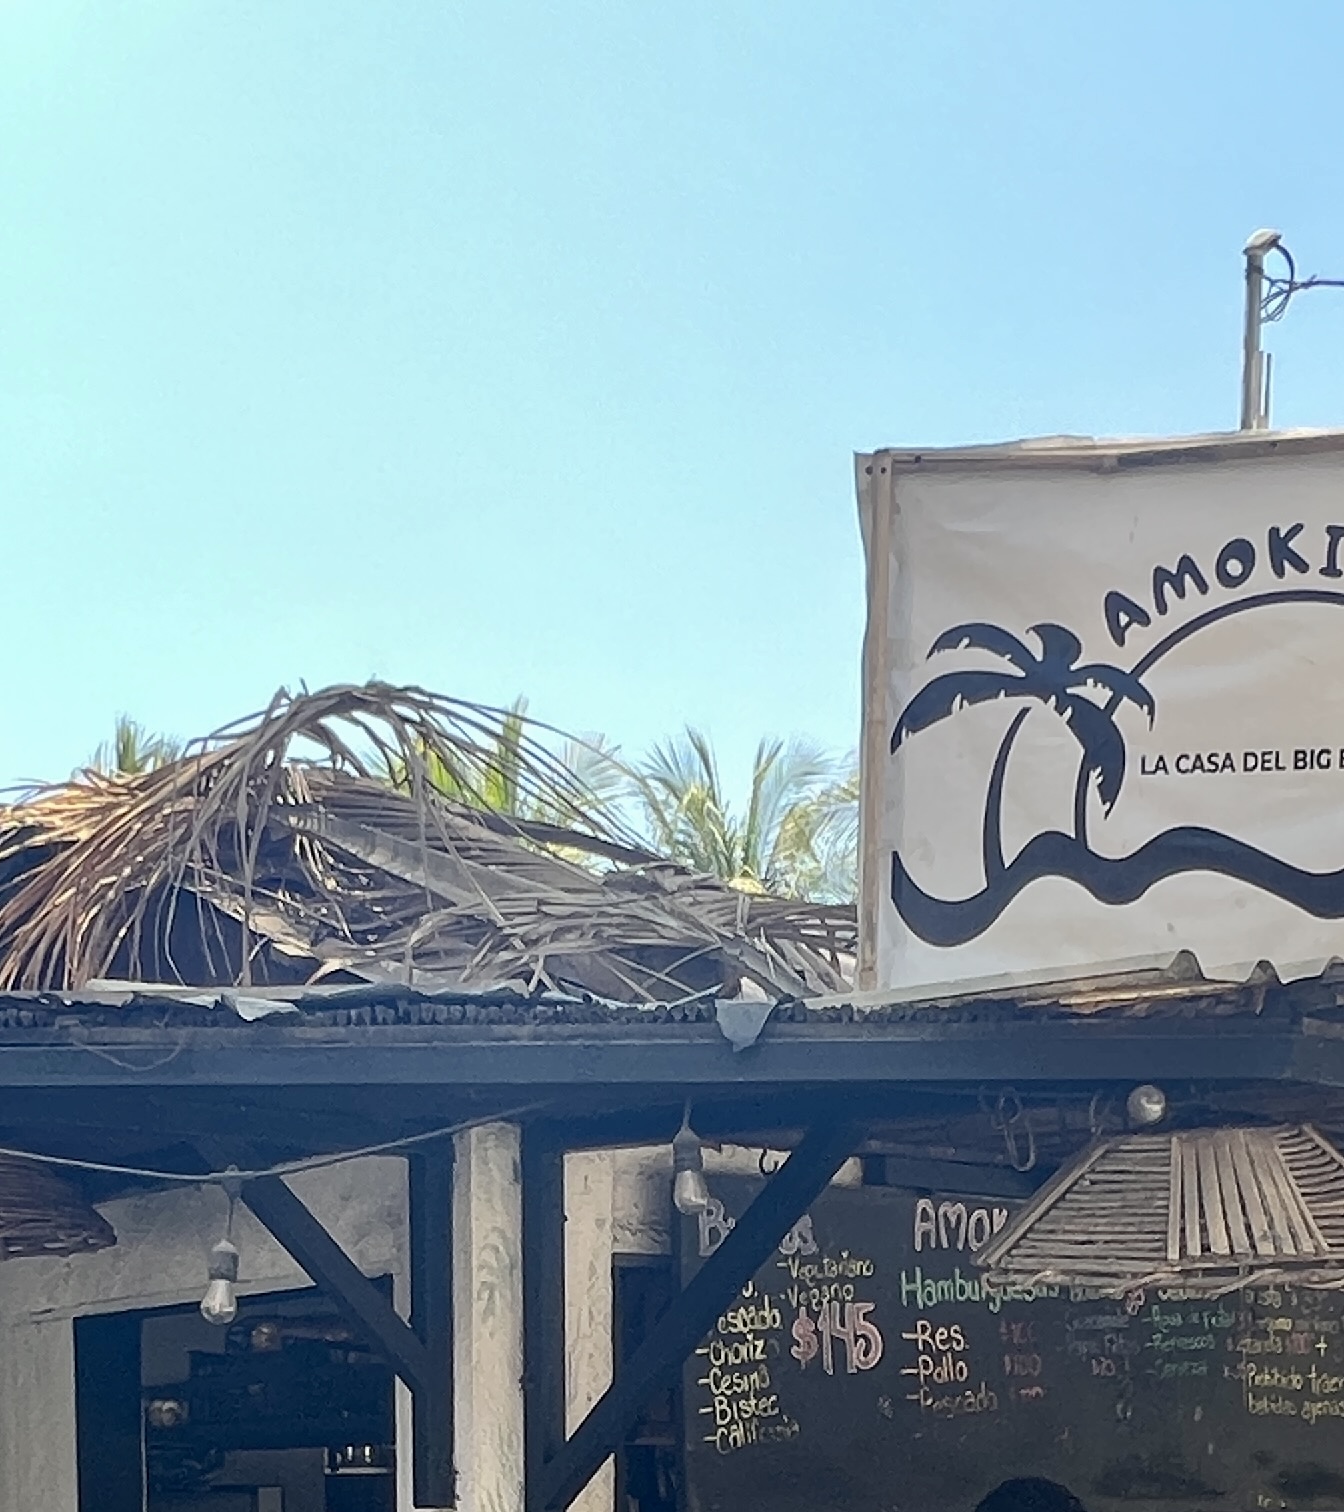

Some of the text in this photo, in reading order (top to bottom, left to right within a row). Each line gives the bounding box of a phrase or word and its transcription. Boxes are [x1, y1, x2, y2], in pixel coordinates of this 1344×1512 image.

[1140, 754, 1170, 776] LA
[1174, 752, 1236, 775] CASA
[1242, 751, 1287, 773] DEL
[1292, 748, 1333, 771] BIG
[790, 1301, 884, 1376] $145
